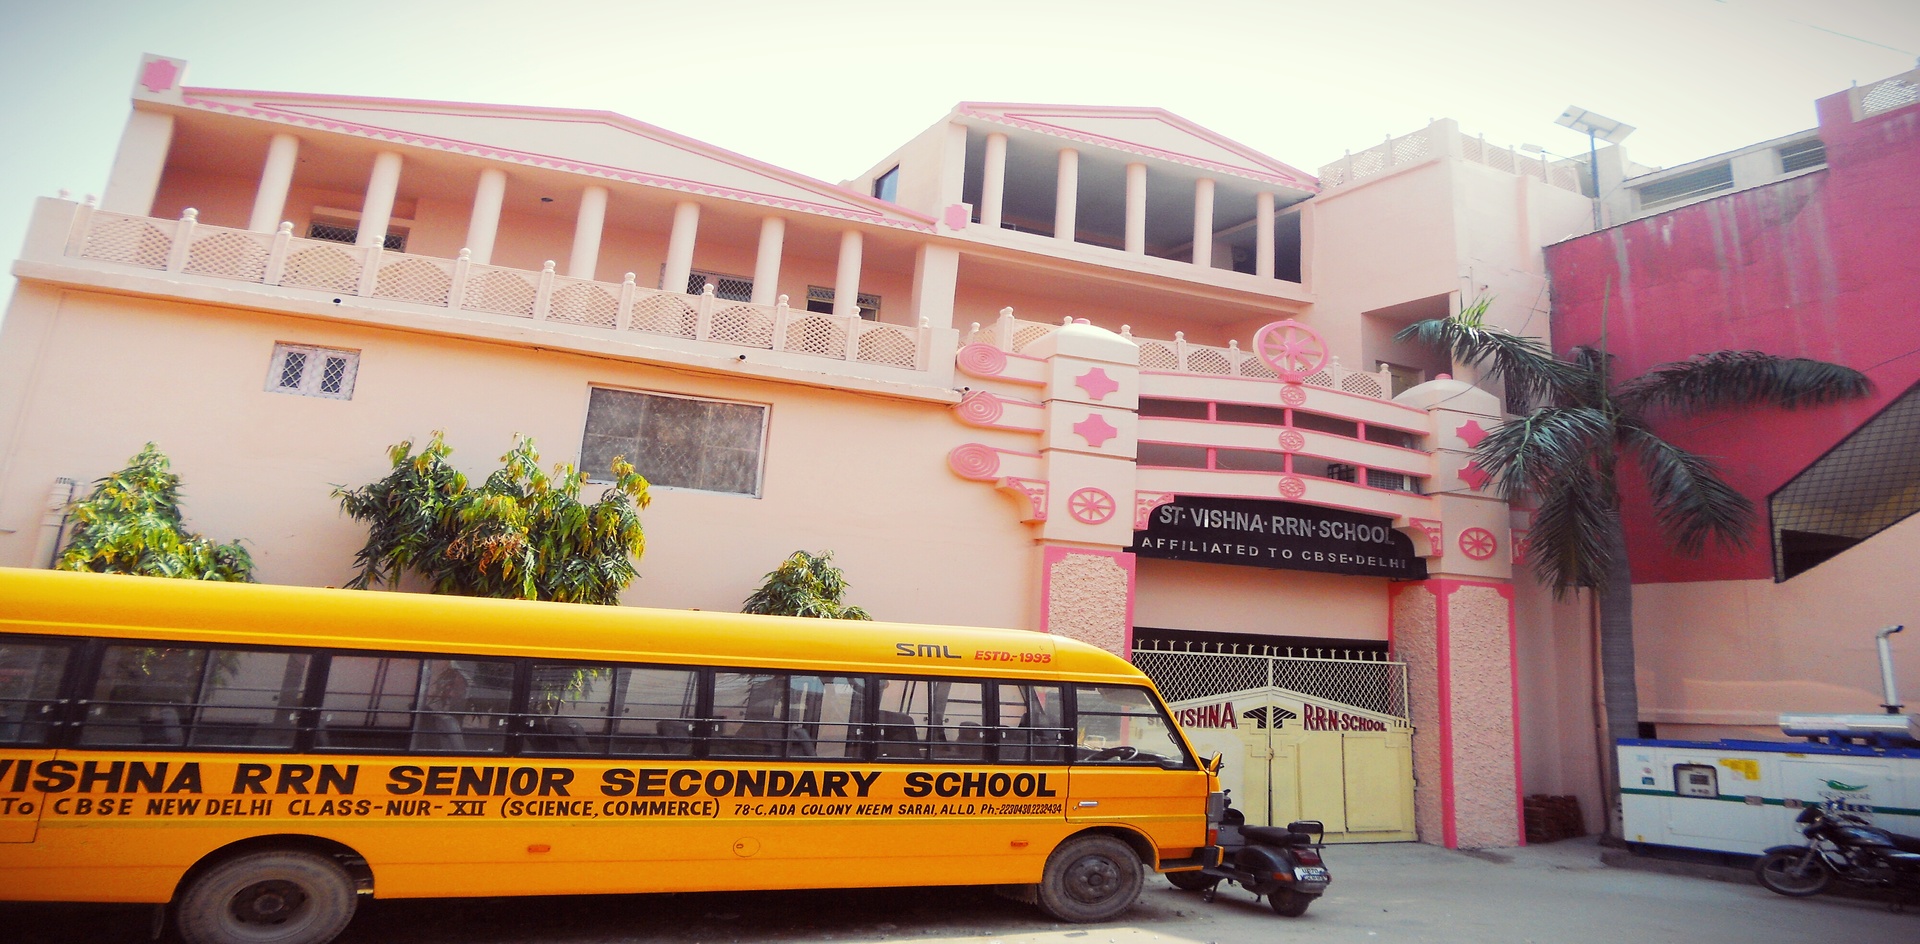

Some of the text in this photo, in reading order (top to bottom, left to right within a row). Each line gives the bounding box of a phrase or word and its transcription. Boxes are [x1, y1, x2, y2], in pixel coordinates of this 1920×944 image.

[1318, 519, 1395, 546] SCHOOL
[1141, 537, 1259, 557] AFFILIATED
[1268, 547, 1293, 560] TO
[1356, 555, 1406, 570] DELHI
[231, 763, 359, 795] RRN
[386, 765, 575, 797] SENIOR
[600, 768, 882, 798] SECONDARY
[903, 771, 1057, 798] SCHOOL
[53, 797, 133, 816] CBSE
[146, 798, 202, 816] NEW
[205, 799, 273, 816] DELHI
[500, 797, 599, 819] (SCIENCE,
[602, 798, 720, 819] COMMERCE)
[801, 803, 853, 816] COLONY
[855, 803, 894, 816] NEEM
